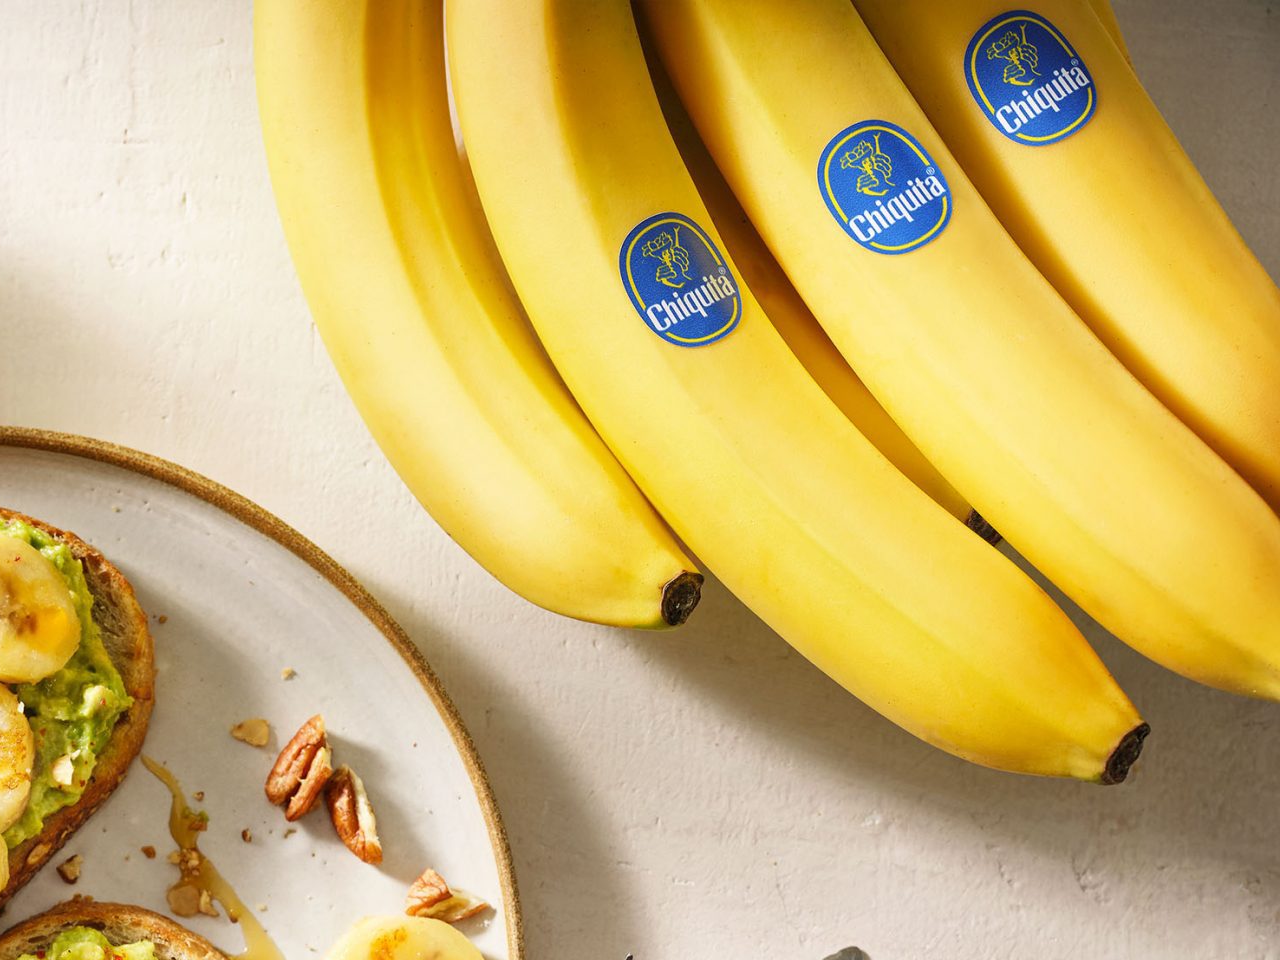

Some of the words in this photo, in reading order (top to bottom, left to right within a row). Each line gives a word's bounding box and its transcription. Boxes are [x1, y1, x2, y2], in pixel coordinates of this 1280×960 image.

[995, 66, 1090, 133] Chiquita
[849, 175, 946, 242] Chiquita
[646, 274, 736, 331] Chiquita
